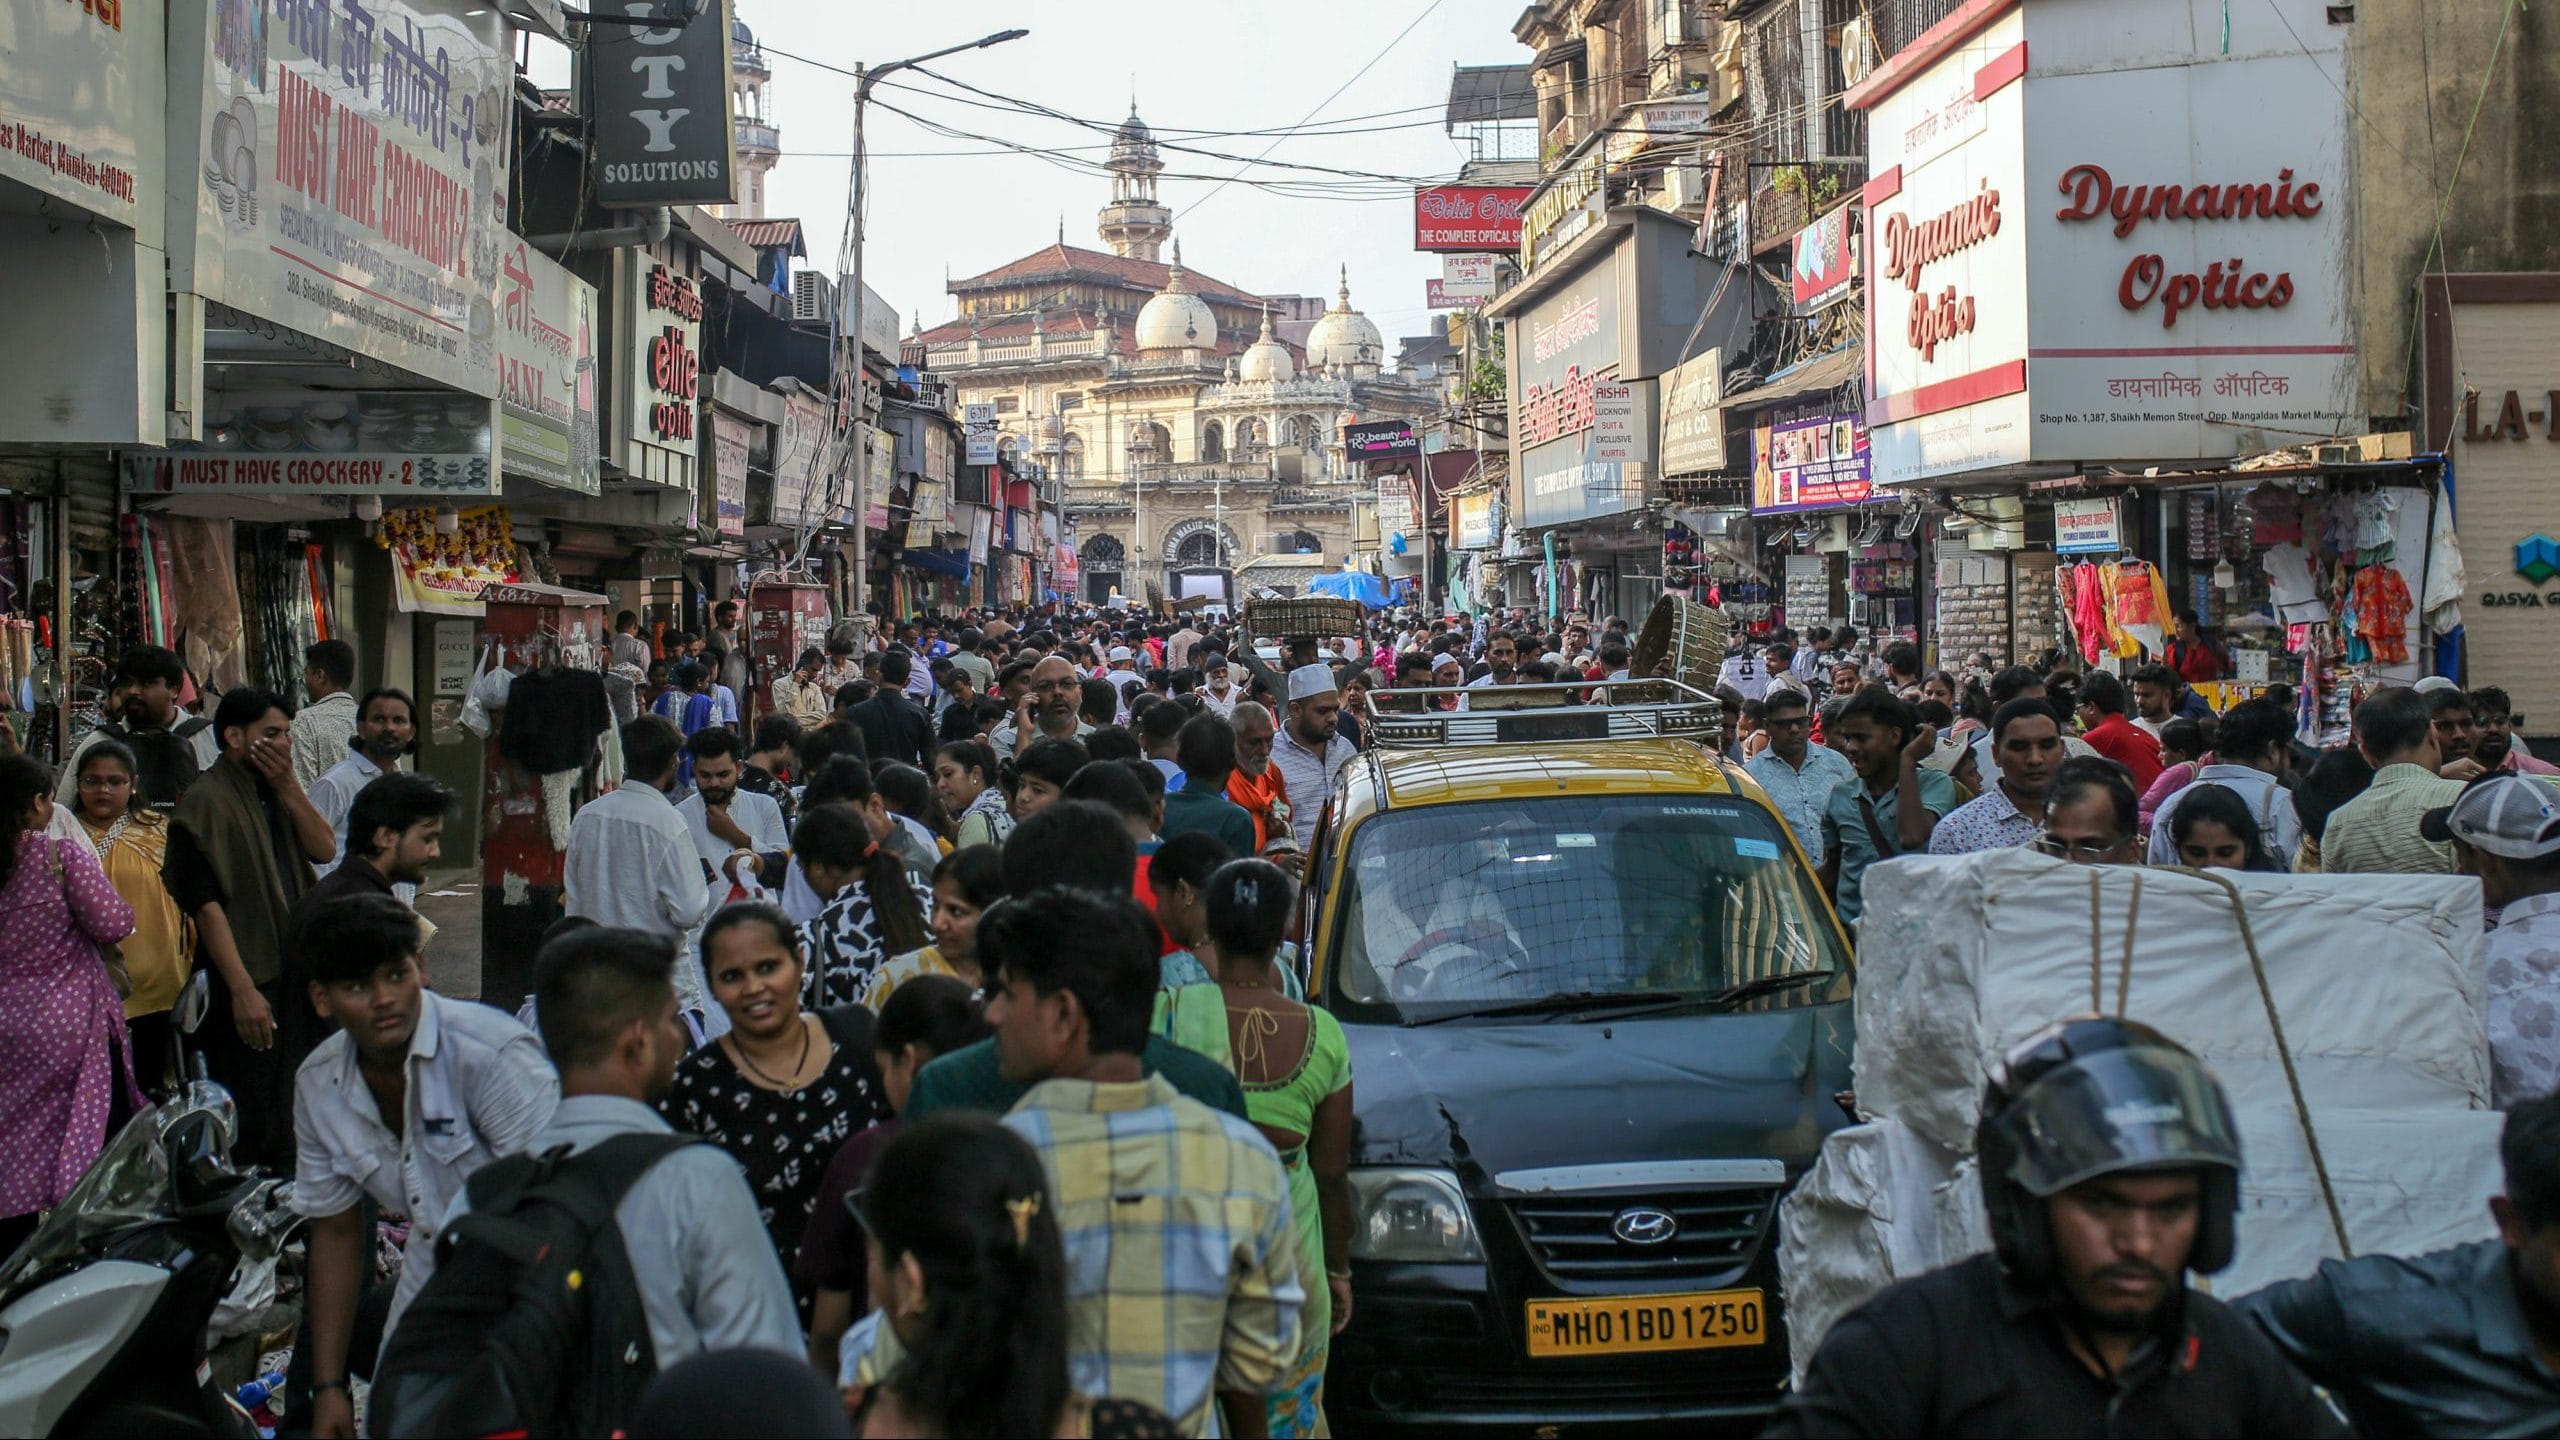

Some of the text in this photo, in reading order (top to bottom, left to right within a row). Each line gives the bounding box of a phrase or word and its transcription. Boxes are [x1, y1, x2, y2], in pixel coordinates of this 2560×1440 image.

[1670, 110, 1686, 121] SOFT
[17, 122, 55, 175] Market,
[276, 63, 331, 205] MUST
[337, 104, 378, 231] HAVE
[605, 160, 719, 184] SOLUTIONS
[1421, 194, 1474, 220] Delta
[2057, 164, 2324, 239] Dynamic
[1420, 229, 1435, 243] THE
[1436, 229, 1477, 243] COMPLETE
[1478, 229, 1511, 243] OPTICAL
[1884, 177, 2001, 291] Dynamic
[2118, 254, 2296, 330] Optics
[654, 325, 698, 401] elite
[1596, 387, 1630, 399] AISHA
[2107, 371, 2289, 398] डायनामिक ऑपटिक
[1595, 408, 1631, 416] LUCKNOWI
[2040, 414, 2063, 424] Shop
[2065, 413, 2081, 423] No.
[2110, 413, 2141, 423] Shaikh
[2143, 412, 2175, 422] Memon
[2208, 411, 2229, 423] Opp.
[2232, 411, 2279, 423] Mangaldas
[2281, 410, 2312, 420] Market
[657, 402, 694, 443] optik
[1602, 421, 1624, 430] SUIT &
[1694, 414, 1711, 434] CO.
[1368, 431, 1400, 442] beauty
[1390, 438, 1417, 448] world
[1596, 435, 1632, 444] EXCLUSIVE
[1601, 449, 1626, 458] KURTIS
[180, 461, 229, 484] MUST
[235, 460, 280, 484] HAVE
[287, 460, 382, 485] CROCKERY
[401, 459, 413, 485] 2
[2482, 592, 2542, 608] QASWA
[1533, 1324, 1550, 1335] IND
[1553, 1302, 1759, 1346] MH01BD1250
